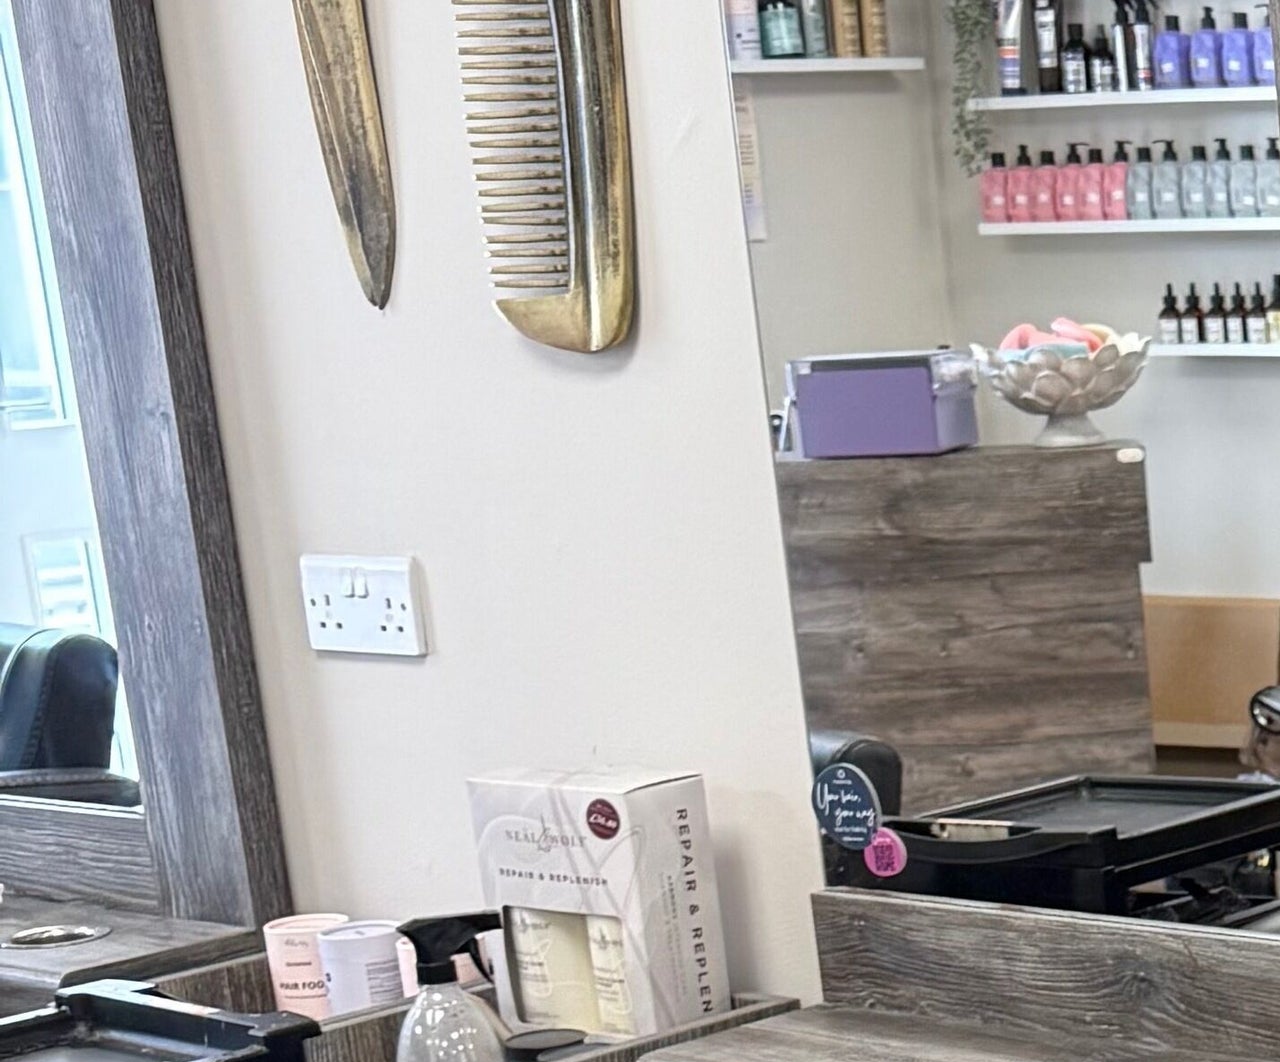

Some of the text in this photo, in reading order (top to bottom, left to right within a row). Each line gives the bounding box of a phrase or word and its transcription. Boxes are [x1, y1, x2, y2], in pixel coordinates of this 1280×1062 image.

[676, 808, 714, 1013] REPAIR & REPLEN
[301, 980, 325, 990] FOO
